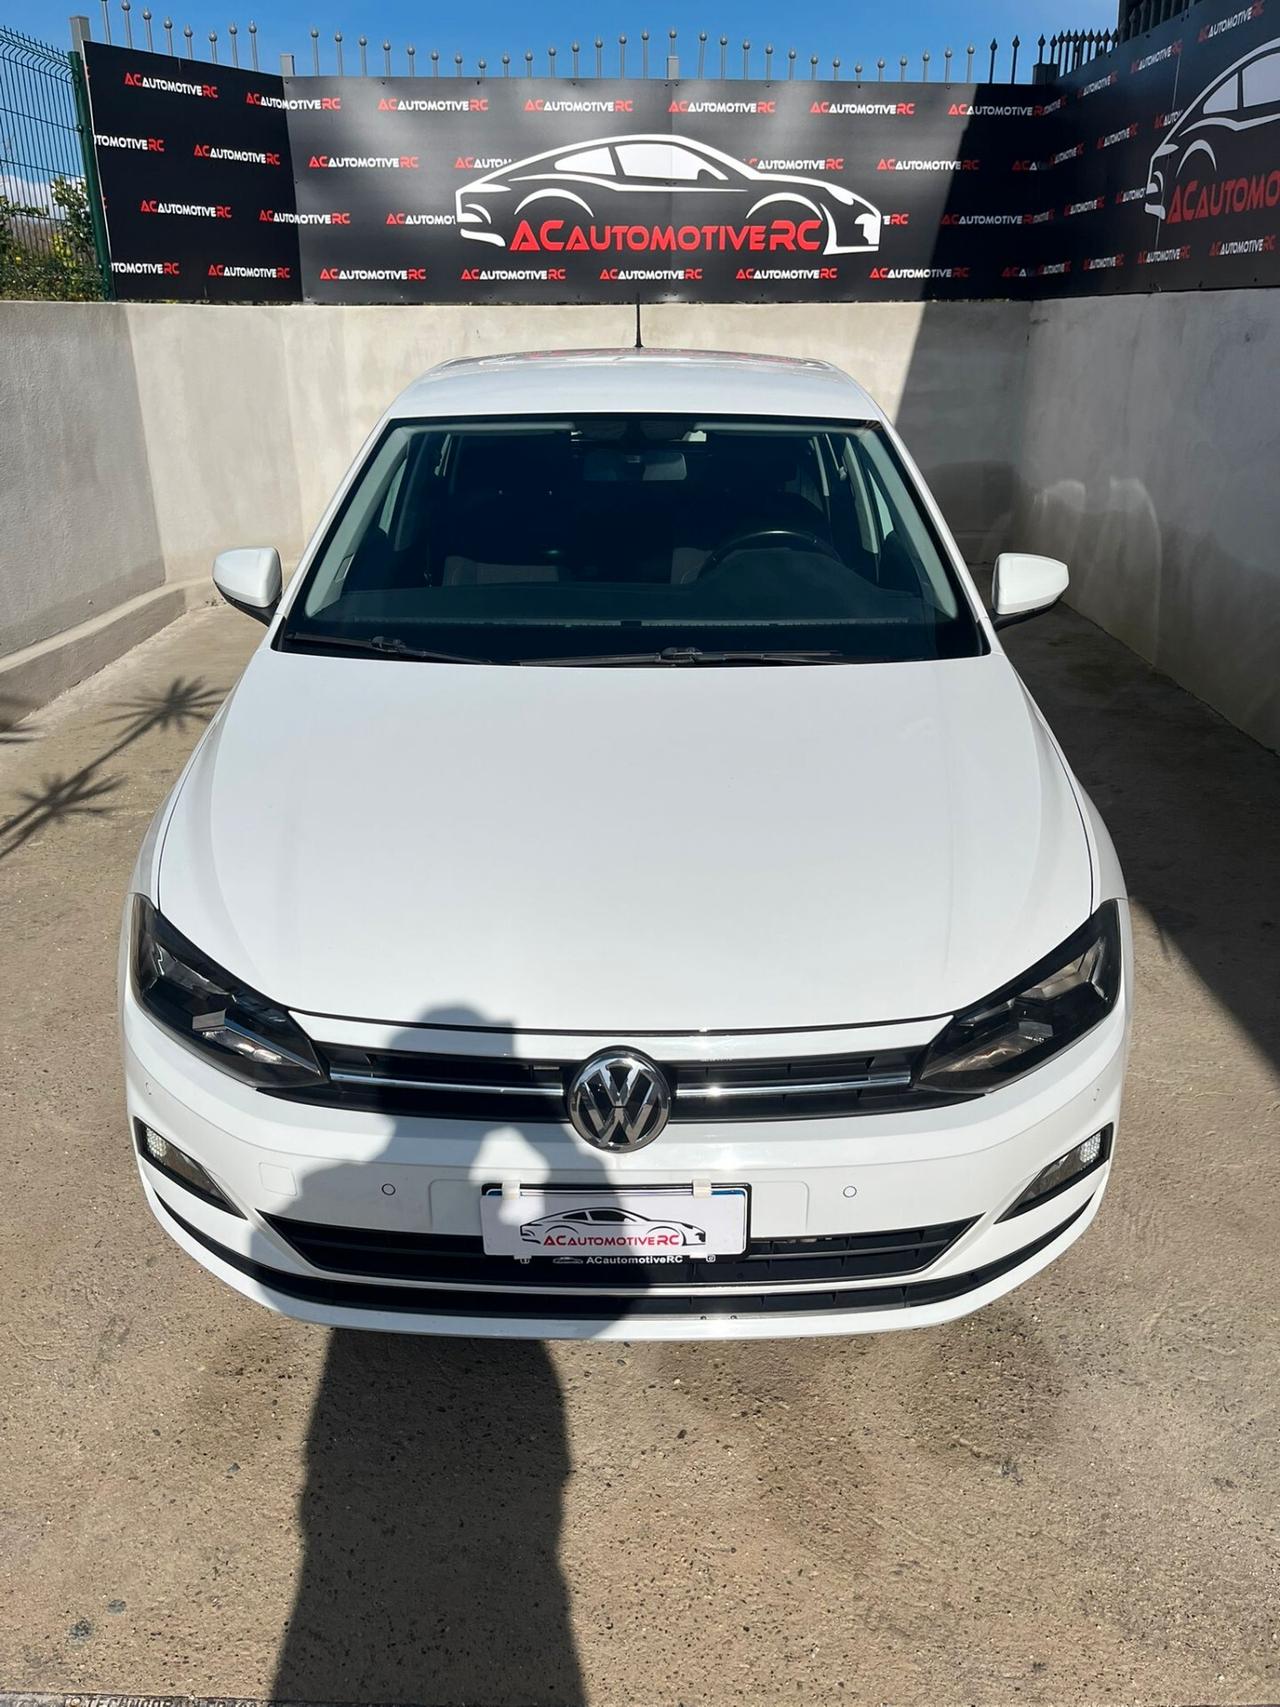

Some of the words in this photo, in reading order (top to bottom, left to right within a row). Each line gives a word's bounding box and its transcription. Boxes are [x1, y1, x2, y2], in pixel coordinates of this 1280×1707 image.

[124, 72, 219, 98] ACAUTOMOTIVERC
[246, 92, 341, 110] ACAUTOMOTIVERC
[378, 98, 489, 112] ACAUTOMOTIVERC
[524, 99, 634, 112] ACAUTOMOTIVERC
[668, 101, 776, 113] ACAUTOMOTIVERC
[810, 102, 916, 115] ACAUTOMOTIVERC
[947, 103, 1043, 118] ACAUTOMOTIVER
[194, 144, 281, 166] ACAUTOMOTIVERC
[308, 155, 419, 168] ACAUTOMOTIVERC
[876, 158, 981, 171] ACAUTOMOTIVERC
[140, 200, 233, 219] ACAUTOMOTIVERC
[259, 209, 351, 225] ACAUTOMOTIVERC
[509, 219, 822, 252] ACAUTOMOTIVERC
[208, 264, 291, 279] ACAUTOMOTIVERC
[320, 268, 427, 280] ACAUTOMOTIVERC
[461, 268, 567, 280] ACAUTOMOTIVERC
[600, 268, 703, 280] ACAUTOMOTIVERC
[736, 267, 838, 280] ACAUTOMOTIVERC
[869, 267, 971, 280] ACAUTOMOTIVERC
[543, 1234, 681, 1246] ACAUTOMOTIVERC
[586, 1255, 683, 1264] ACautomotiveRC
